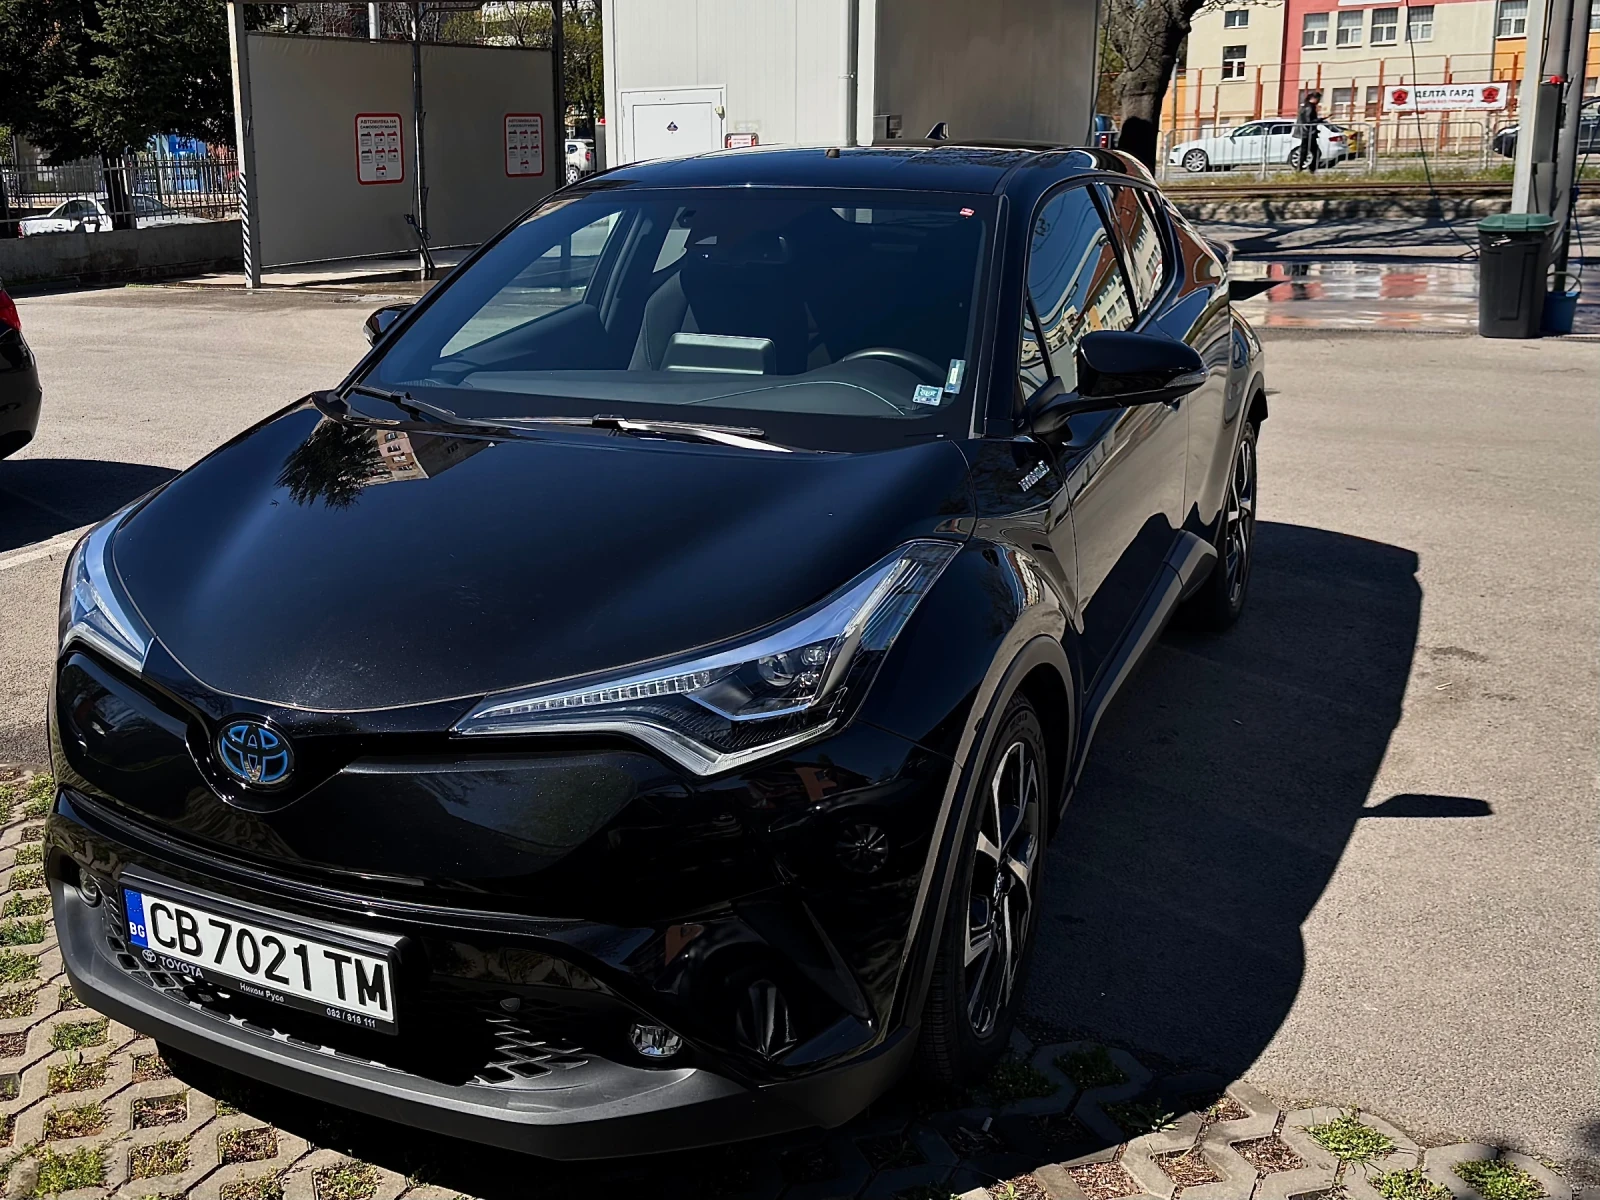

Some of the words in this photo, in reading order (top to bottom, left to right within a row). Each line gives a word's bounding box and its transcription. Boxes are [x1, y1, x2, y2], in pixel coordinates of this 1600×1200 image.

[1415, 90, 1447, 98] ДЕЛТА
[1449, 89, 1475, 97] ГАРД
[129, 921, 146, 938] BG
[159, 955, 204, 979] TOYOTA
[326, 1007, 341, 1019] 082
[347, 1013, 361, 1024] 818
[363, 1017, 376, 1028] 111
